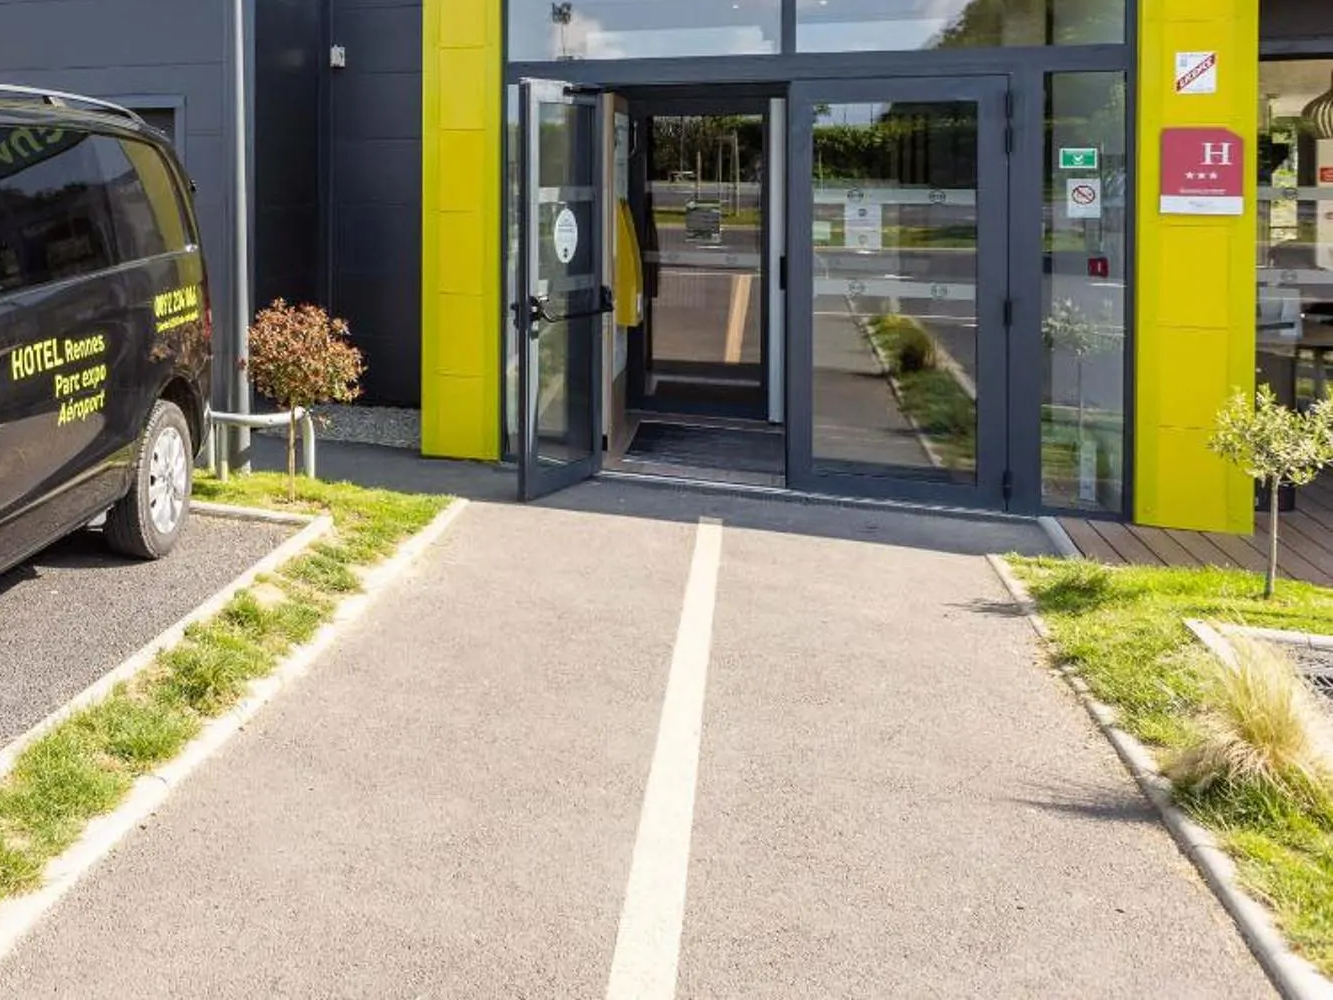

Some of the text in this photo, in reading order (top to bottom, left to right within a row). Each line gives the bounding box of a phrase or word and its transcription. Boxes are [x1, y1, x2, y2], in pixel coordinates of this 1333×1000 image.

[1200, 142, 1233, 166] H
[11, 334, 105, 380] HOTEL Rennes
[55, 364, 107, 398] Parc expo
[57, 389, 105, 427] Aéroport
